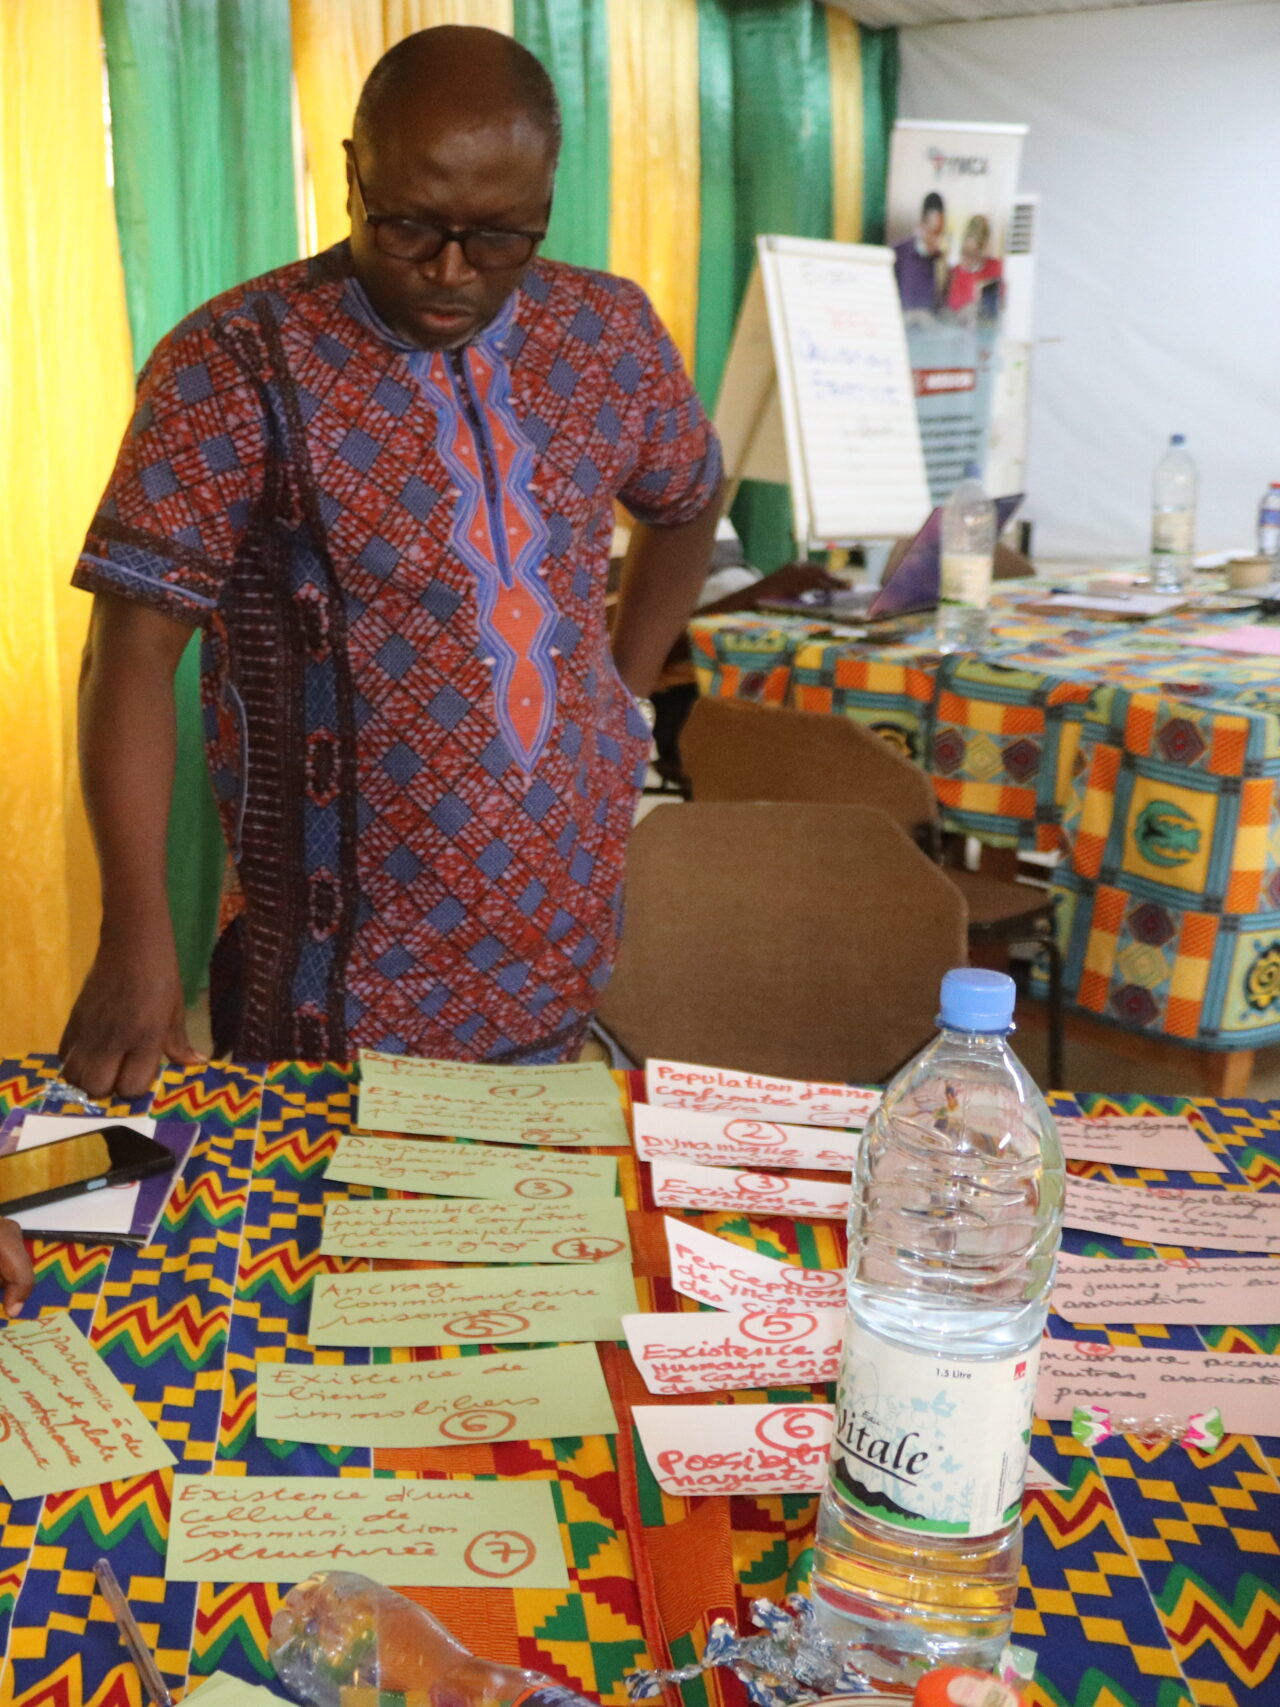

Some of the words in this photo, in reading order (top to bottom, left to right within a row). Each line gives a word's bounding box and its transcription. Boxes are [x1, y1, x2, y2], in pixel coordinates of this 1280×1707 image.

[657, 1066, 793, 1092] Population
[740, 1122, 773, 1140] 2
[640, 1135, 804, 1159] Dynamique
[815, 1150, 855, 1161] En
[534, 1181, 553, 1196] 3
[756, 1173, 775, 1189] 3
[658, 1178, 818, 1207] Existence
[677, 1263, 713, 1284] de
[679, 1280, 724, 1302] des
[1176, 1280, 1232, 1292] pour
[762, 1313, 795, 1336] 5
[642, 1337, 815, 1361] Existence
[823, 1338, 843, 1356] d
[272, 1368, 463, 1387] Existence
[481, 1363, 530, 1374] de
[936, 1367, 950, 1378] 1.5
[952, 1369, 972, 1379] Litre
[461, 1414, 489, 1432] 6
[783, 1413, 815, 1439] 6
[836, 1408, 929, 1476] Vitale
[178, 1484, 368, 1503] Existence
[385, 1485, 475, 1503] d'une
[362, 1508, 412, 1523] de
[183, 1541, 441, 1564] structurée
[482, 1540, 527, 1563] 7
